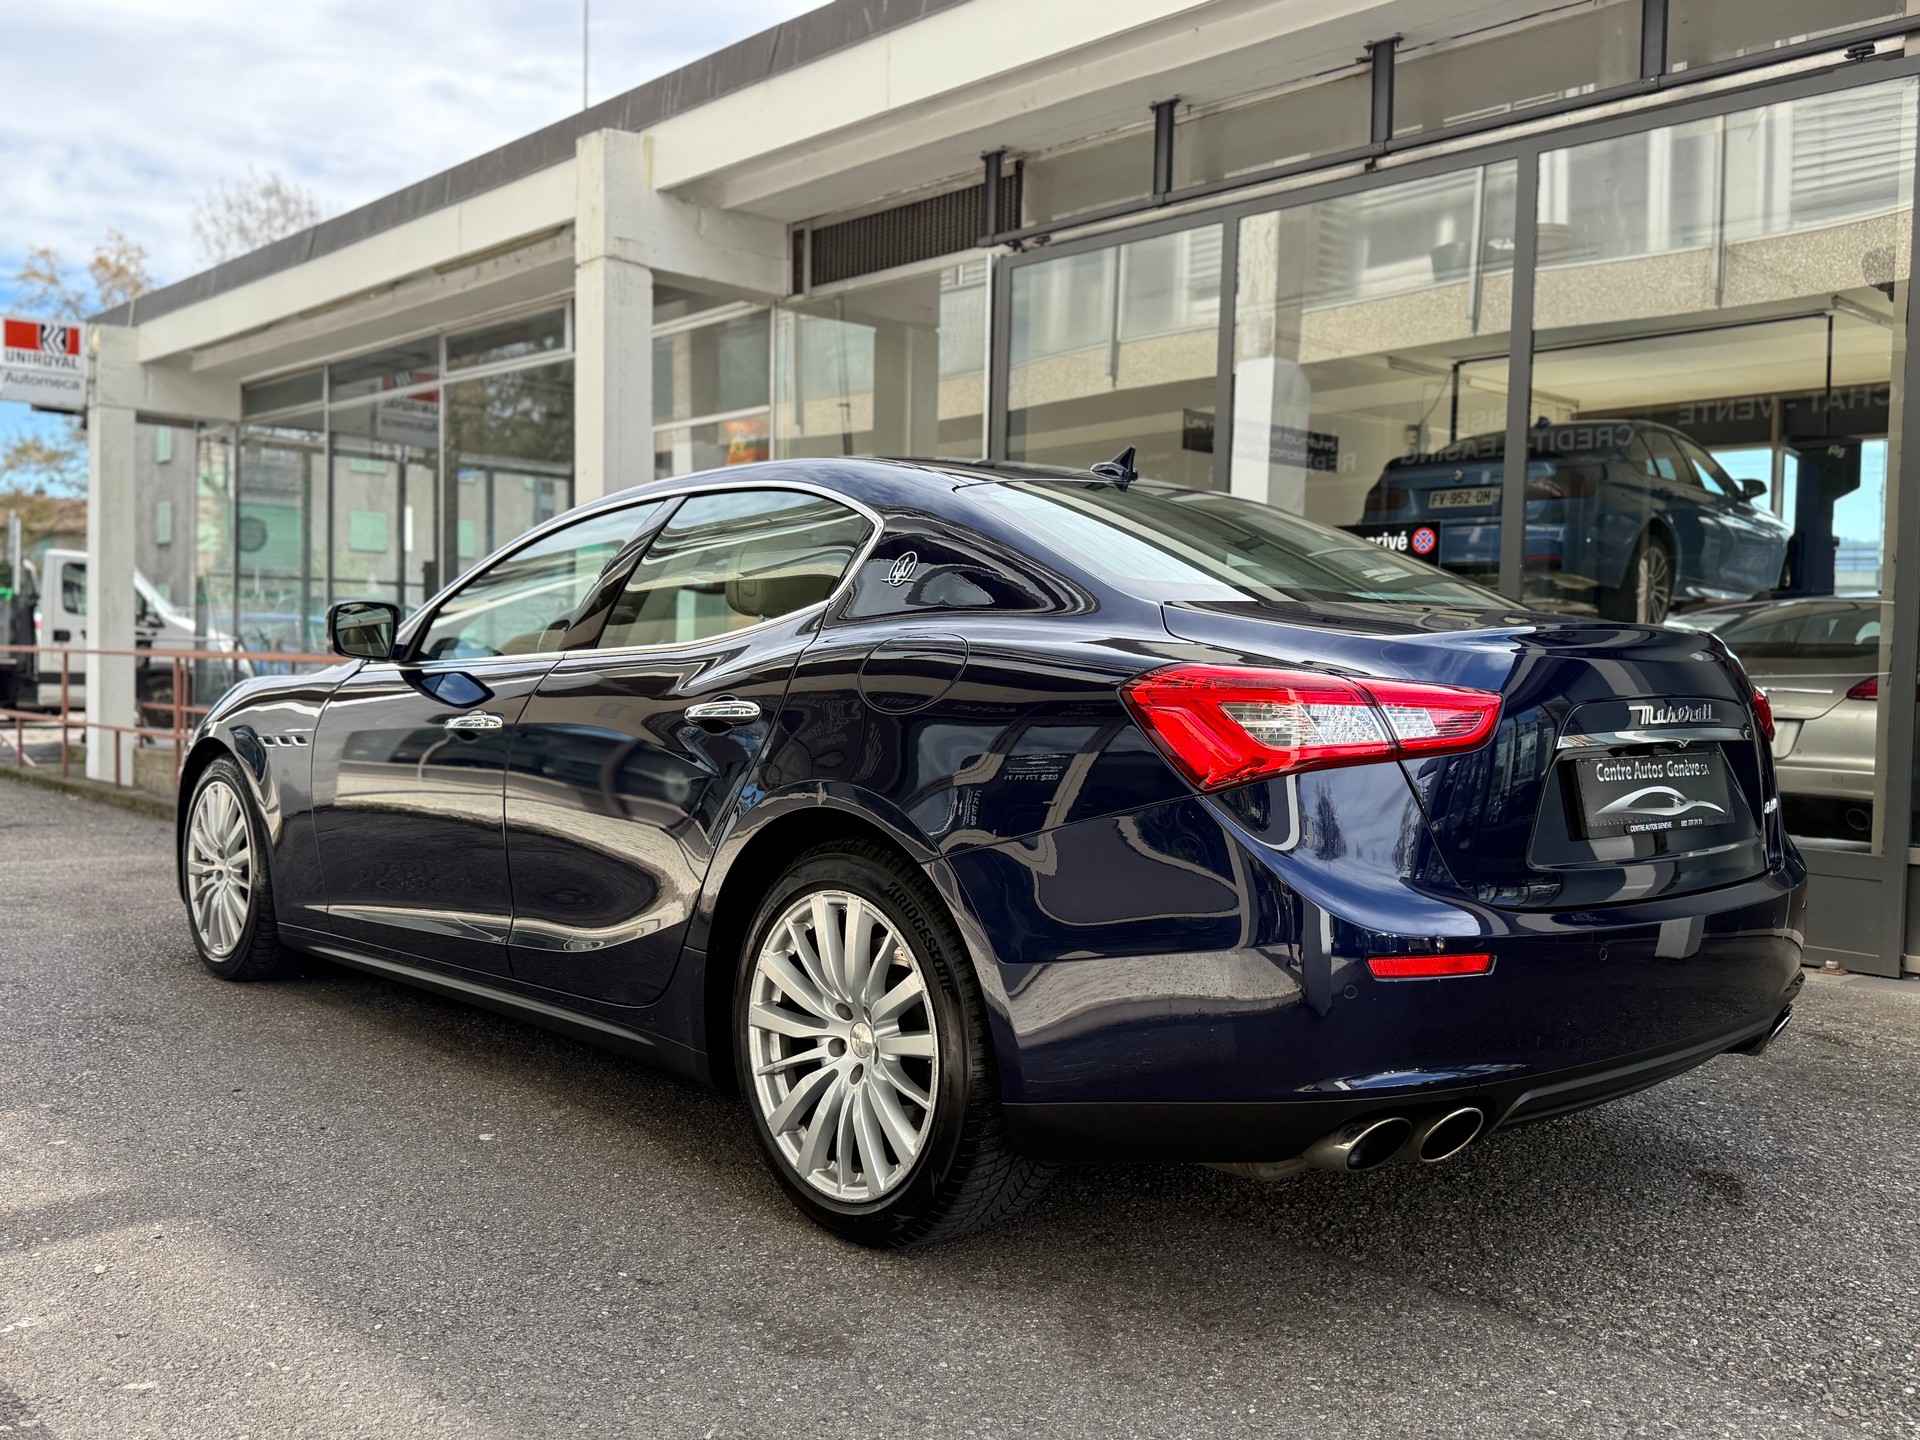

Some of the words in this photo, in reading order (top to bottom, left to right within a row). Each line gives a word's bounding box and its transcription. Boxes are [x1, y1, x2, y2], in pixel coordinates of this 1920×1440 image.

[5, 350, 79, 370] UNIROYAL
[4, 371, 80, 391] Automeca
[1628, 704, 1721, 726] Maserati
[1596, 763, 1632, 782] Centre
[1634, 761, 1664, 779] Autos
[1667, 759, 1701, 778] Genève
[1701, 763, 1710, 776] SA
[885, 881, 955, 997] BRIDGESTONE
